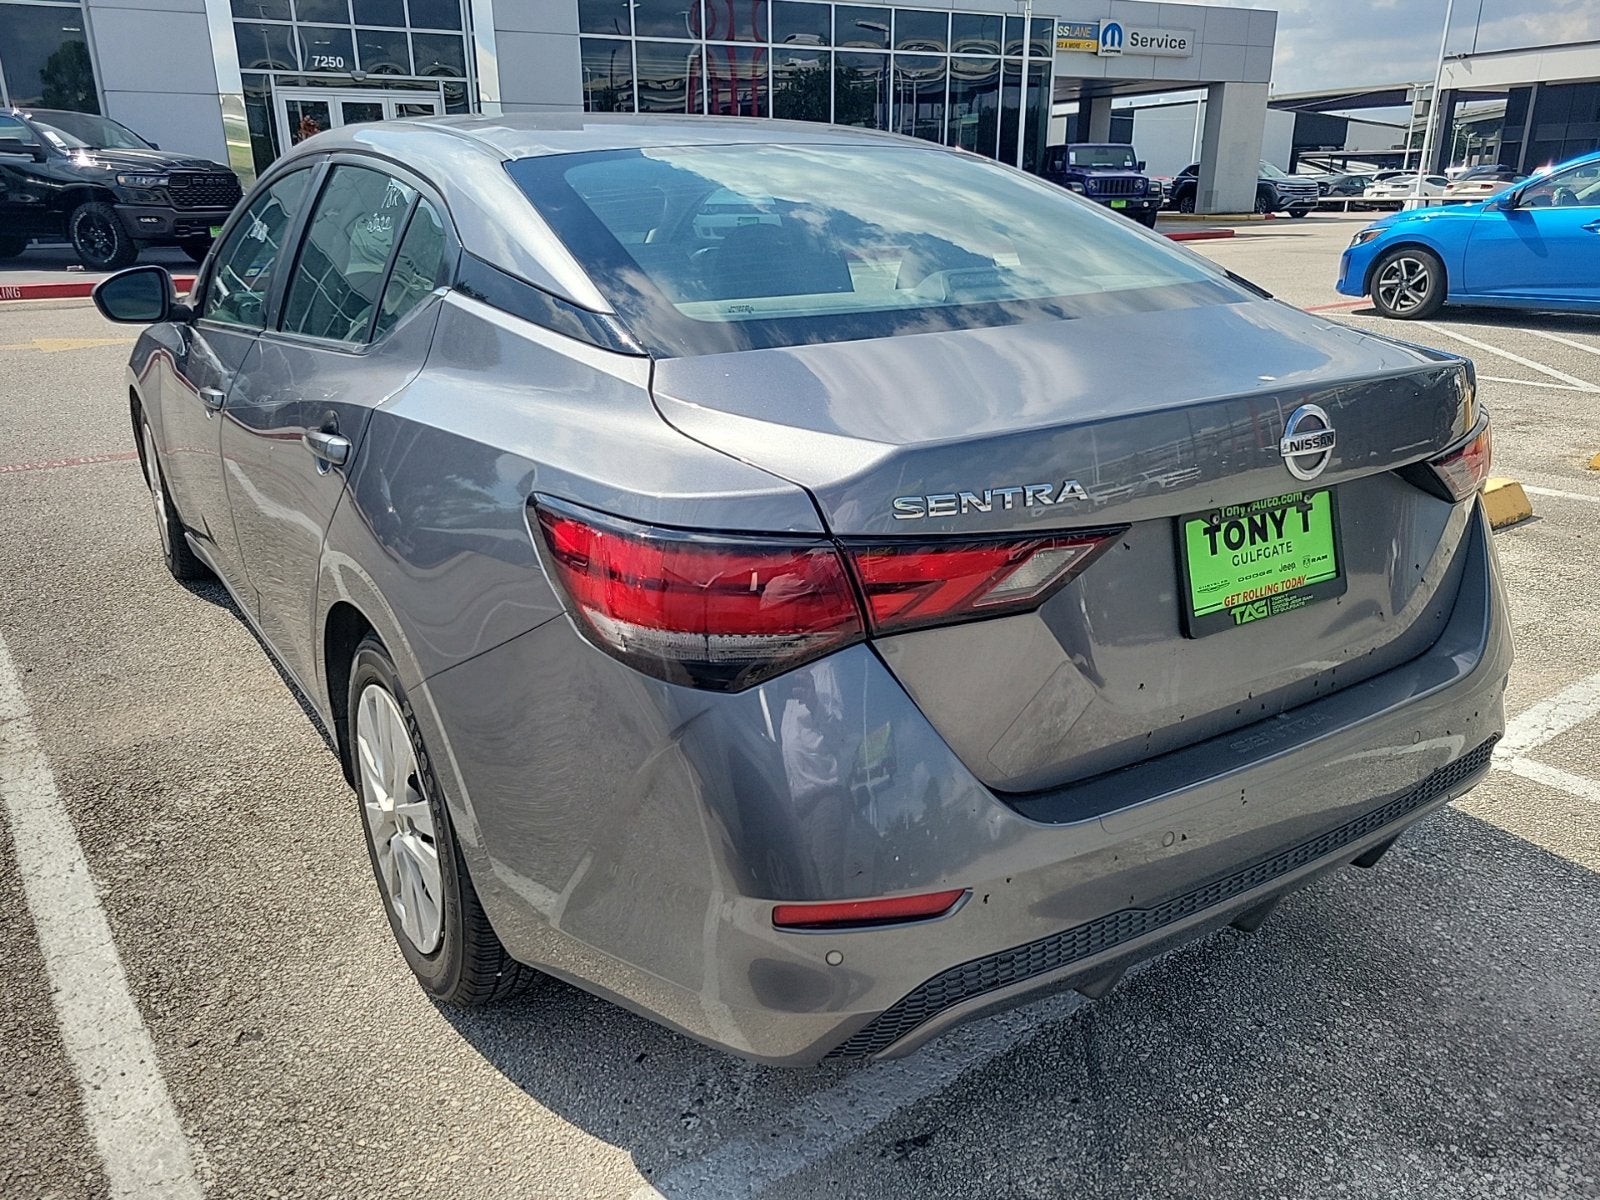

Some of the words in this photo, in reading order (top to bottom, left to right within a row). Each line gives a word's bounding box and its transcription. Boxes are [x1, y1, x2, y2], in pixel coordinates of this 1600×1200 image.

[1130, 32, 1186, 50] Service
[311, 55, 344, 68] 7250
[0, 286, 21, 299] ING
[1289, 434, 1334, 452] NISSAN
[893, 479, 1089, 520] SENTRA
[1203, 508, 1288, 556] TONY
[1296, 501, 1313, 533] T
[1231, 540, 1293, 567] GULFGATE
[1237, 569, 1273, 582] DODGE
[1279, 562, 1296, 573] Jeep
[1311, 554, 1328, 563] RAM
[1224, 592, 1241, 607] GET
[1242, 582, 1279, 602] ROLLING
[1280, 574, 1307, 591] TODAY
[1229, 600, 1267, 625] TAG
